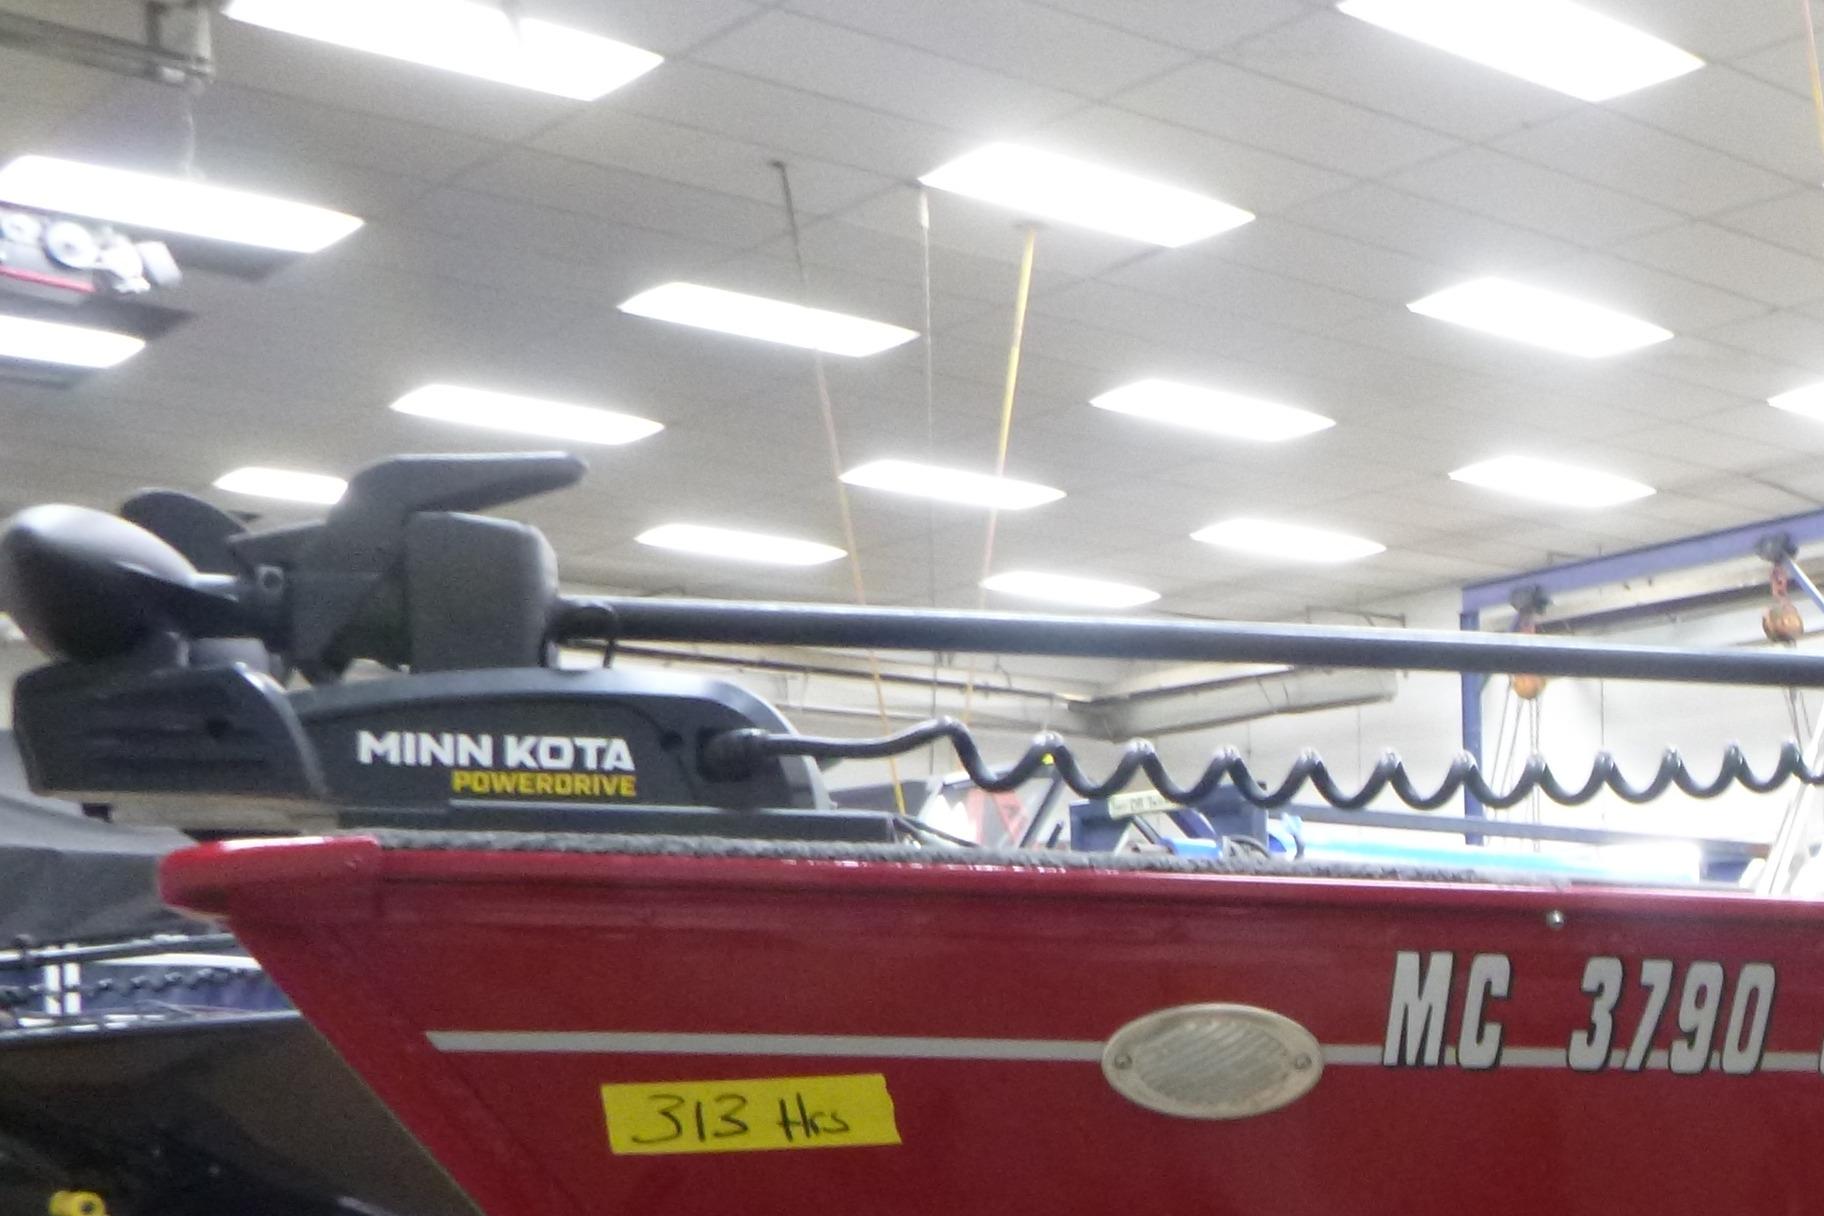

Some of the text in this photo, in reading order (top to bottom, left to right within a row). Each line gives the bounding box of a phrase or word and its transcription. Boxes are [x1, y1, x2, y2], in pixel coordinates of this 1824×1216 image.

[357, 731, 635, 771] MINN KOTA
[451, 770, 637, 797] POWERDRIVE
[1382, 950, 1511, 1070] MC
[1567, 957, 1777, 1077] 3790
[631, 1092, 850, 1144] 313 Hrs
